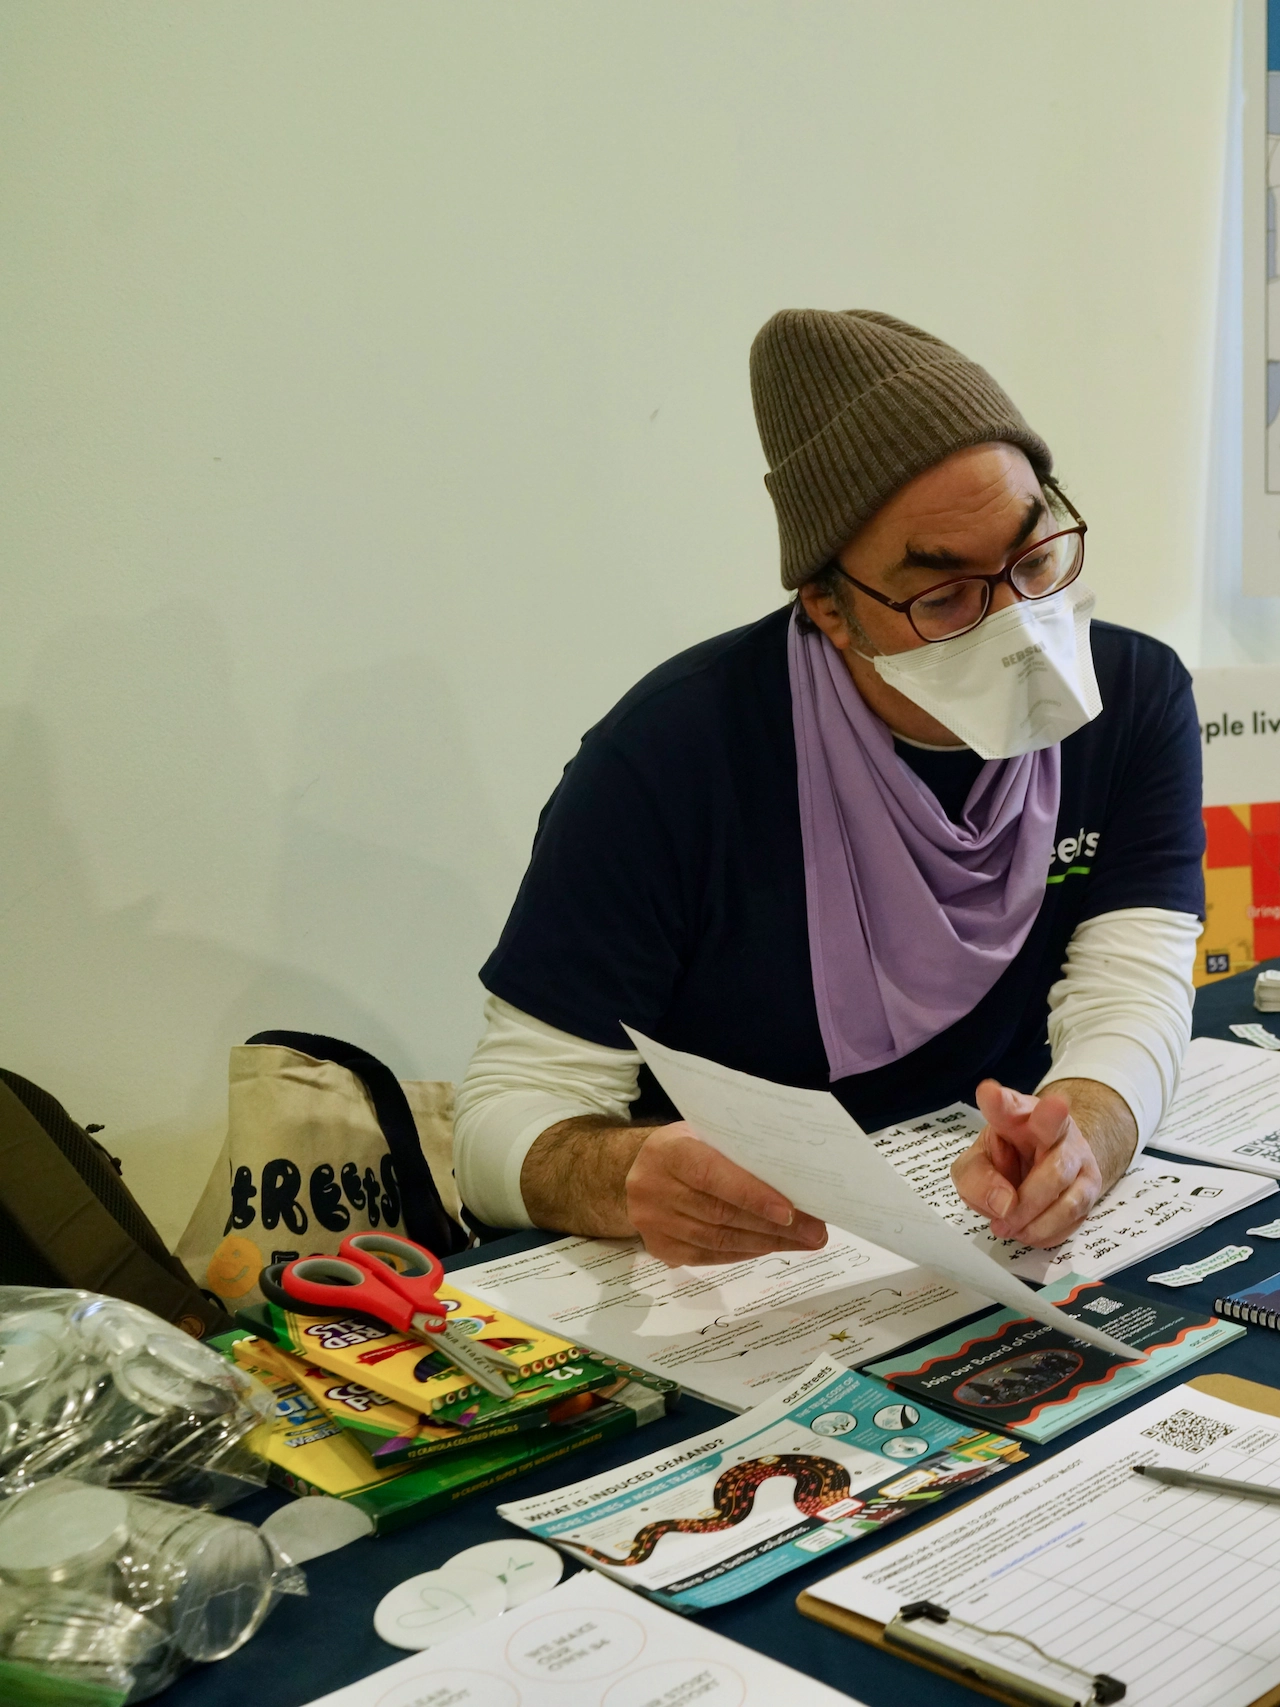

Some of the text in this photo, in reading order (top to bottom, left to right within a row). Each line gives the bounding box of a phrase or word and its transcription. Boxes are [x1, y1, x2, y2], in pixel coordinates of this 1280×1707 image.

[1199, 712, 1244, 744] ple
[1208, 956, 1228, 971] 55
[544, 1366, 583, 1381] 12
[920, 1372, 952, 1391] Join
[951, 1363, 973, 1378] our
[971, 1342, 1013, 1368] Board
[1011, 1334, 1027, 1349] of
[782, 1365, 833, 1404] our streets
[825, 1384, 846, 1400] COST
[417, 1441, 453, 1457] CRAYOLA
[452, 1432, 489, 1447] COLORED
[490, 1424, 519, 1438] PENCILS
[495, 1468, 517, 1484] SUPER
[519, 1461, 534, 1474] TIPS
[524, 1503, 572, 1523] WHAT
[573, 1498, 588, 1512] IS
[589, 1470, 655, 1502] INDUCED
[655, 1438, 726, 1473] DEMAND?
[545, 1517, 584, 1534] MORE
[584, 1500, 624, 1522] LANES
[633, 1482, 669, 1502] MORE
[668, 1461, 714, 1485] TRAFFIC
[722, 1549, 759, 1571] better
[551, 1621, 599, 1647] MAKE
[537, 1648, 571, 1665] OUR
[547, 1648, 590, 1672] OWN
